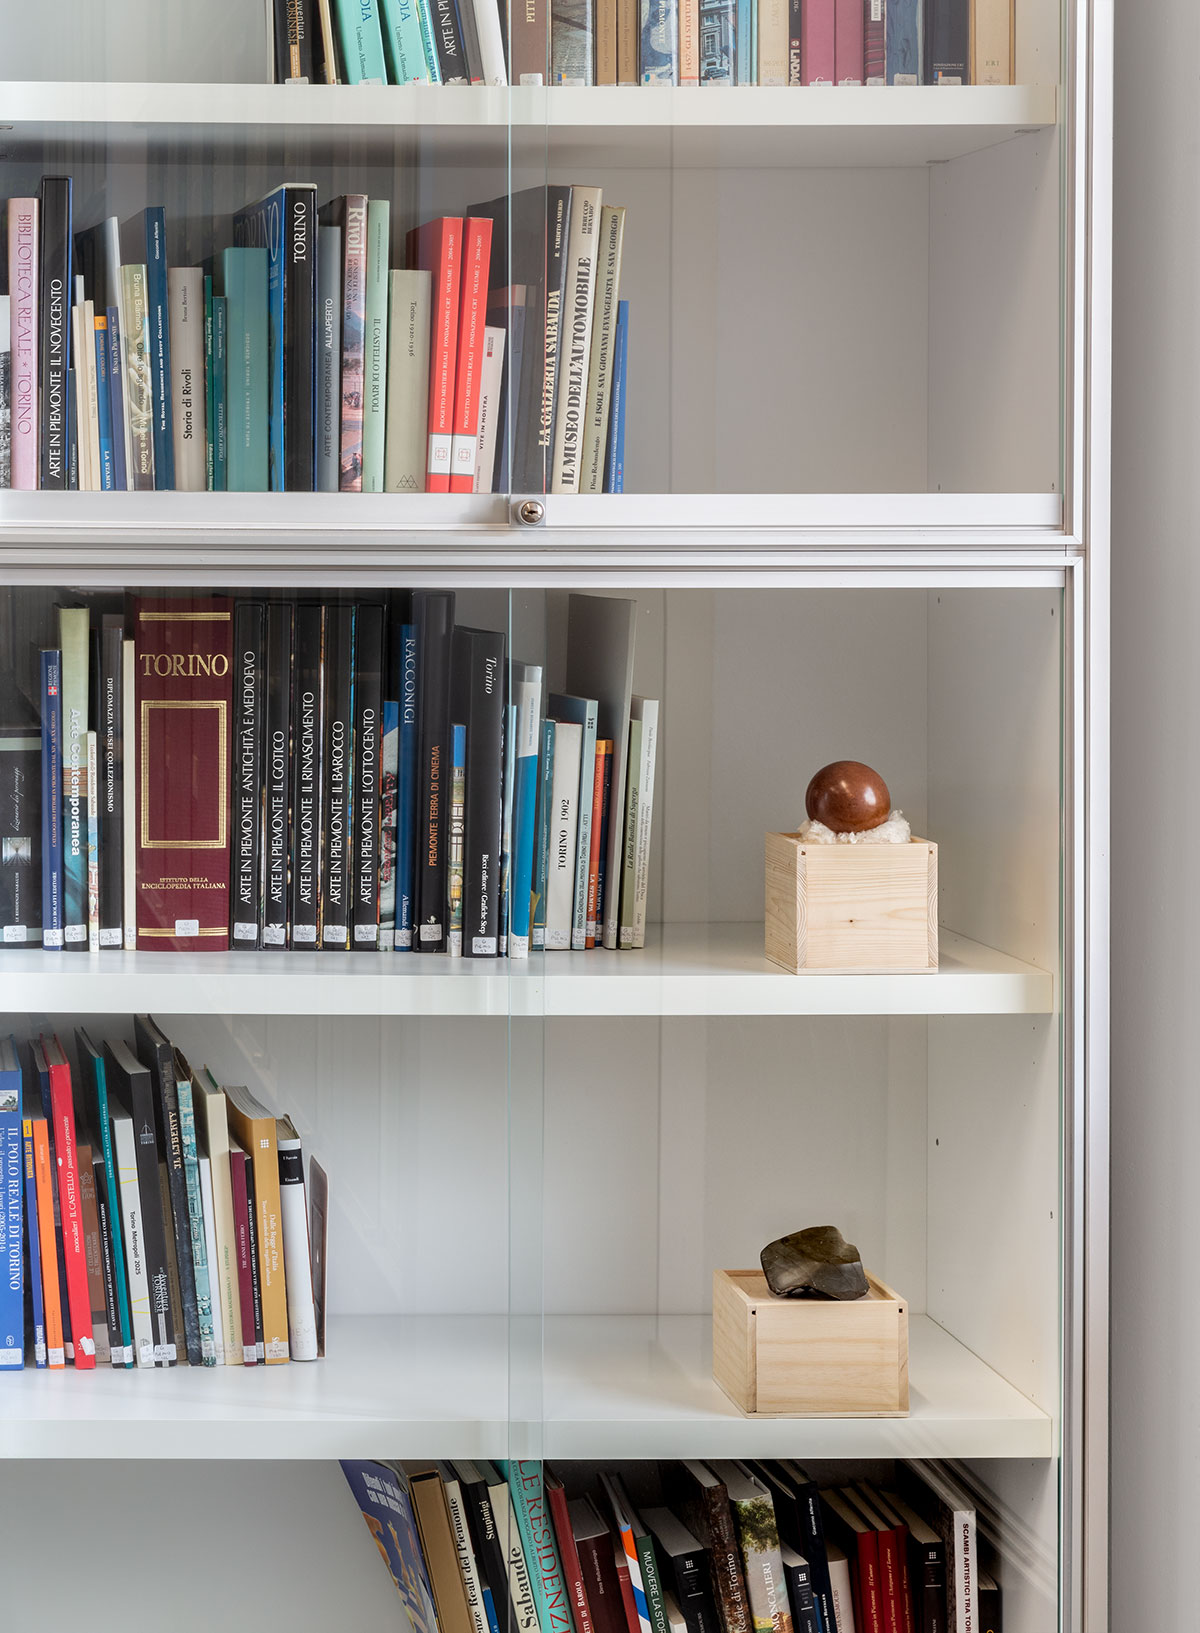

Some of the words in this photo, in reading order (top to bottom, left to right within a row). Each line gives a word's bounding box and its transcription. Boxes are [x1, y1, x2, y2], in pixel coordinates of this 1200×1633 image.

[440, 12, 453, 27] IN
[355, 26, 365, 52] Umberto
[394, 25, 405, 52] Umberto
[443, 27, 458, 57] ARTE
[293, 201, 307, 263] TORINO
[347, 206, 365, 255] Rivoli
[581, 200, 590, 235] FERRUCCIO
[17, 213, 32, 303] BIBLIOTECA
[17, 307, 32, 357] REALE
[49, 279, 63, 354] NOVECENTO
[371, 318, 381, 327] IL
[544, 289, 561, 354] SABAUDA
[565, 256, 592, 408] DELL'AUTOMOBILE
[49, 356, 63, 366] IL
[371, 327, 381, 372] CASTELLO
[180, 368, 194, 395] Rivoli
[371, 372, 381, 383] DI
[539, 355, 558, 428] GALLERIA
[17, 373, 32, 435] TORINO
[49, 371, 63, 430] PIEMONTE
[180, 397, 194, 409] di
[371, 384, 381, 413] RIVOLI
[49, 432, 63, 447] IN
[180, 410, 194, 440] Storia
[537, 429, 551, 446] LA
[561, 410, 582, 467] MUSEO
[49, 448, 63, 479] ARTE
[560, 468, 575, 486] IL
[139, 653, 229, 677] TORINO
[483, 656, 497, 694] Torino
[402, 637, 417, 725] RACCONIGI
[300, 691, 314, 782] RINASCIMENTO
[329, 721, 344, 782] BAROCCO
[359, 708, 375, 793] L'OTTOCENTO
[270, 731, 285, 781] GOTICO
[270, 783, 285, 791] IL
[300, 784, 314, 793] IL
[329, 784, 344, 793] IL
[557, 799, 570, 822] 1902
[270, 797, 285, 856] PIEMONTE
[300, 798, 314, 858] PIEMONTE
[329, 798, 344, 858] PIEMONTE
[359, 798, 375, 858] PIEMONTE
[557, 829, 570, 870] TORINO
[270, 858, 285, 873] IN
[300, 860, 314, 874] IN
[329, 860, 344, 874] IN
[359, 860, 375, 874] IN
[270, 874, 285, 904] ARTE
[300, 876, 314, 905] ARTE
[329, 876, 344, 905] ARTE
[359, 876, 375, 905] ARTE
[7, 1127, 21, 1140] IL
[7, 1142, 21, 1177] POLO
[7, 1179, 21, 1223] REALE
[7, 1224, 21, 1238] DI
[129, 1210, 137, 1229] Torino
[130, 1230, 140, 1259] Metropoli
[7, 1240, 21, 1291] TORINO
[134, 1259, 142, 1275] 2025
[449, 1497, 468, 1553] Piemonte
[478, 1499, 496, 1541] Stupinigi
[962, 1523, 970, 1556] SCAMBI
[458, 1555, 471, 1574] del
[642, 1551, 659, 1596] MUOVERE
[651, 1597, 661, 1608] LA
[963, 1556, 971, 1597] ARTISTICI
[464, 1576, 479, 1607] Reali
[506, 1546, 538, 1630] Sabaude
[761, 1561, 781, 1632] MONCALIERI
